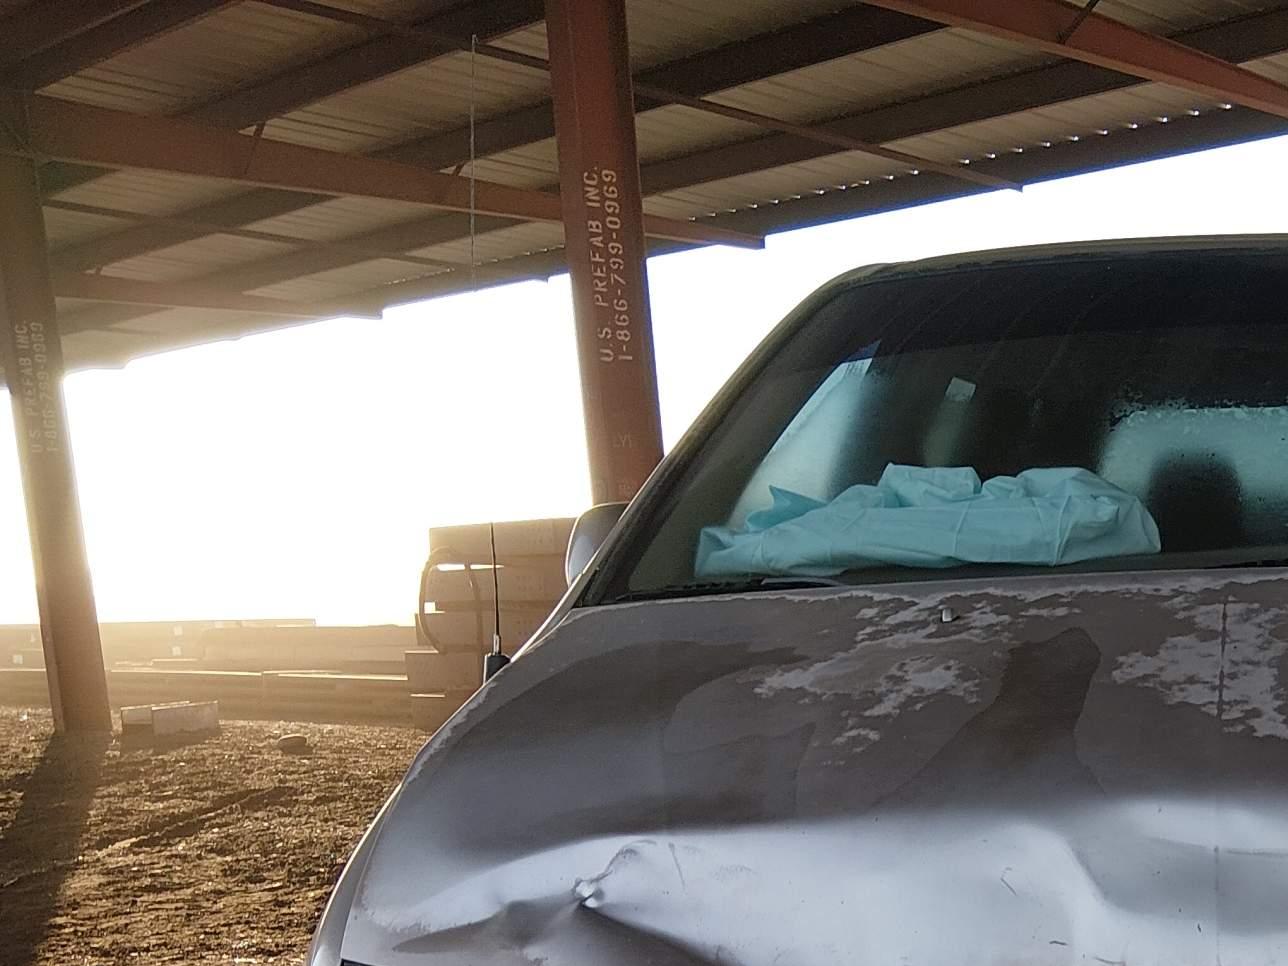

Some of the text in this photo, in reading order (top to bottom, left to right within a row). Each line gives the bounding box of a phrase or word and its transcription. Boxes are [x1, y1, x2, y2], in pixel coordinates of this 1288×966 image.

[583, 165, 615, 363] U.S. PREFAB INC.
[601, 169, 633, 361] 1-866-799-0969
[18, 356, 38, 416] PREFAB
